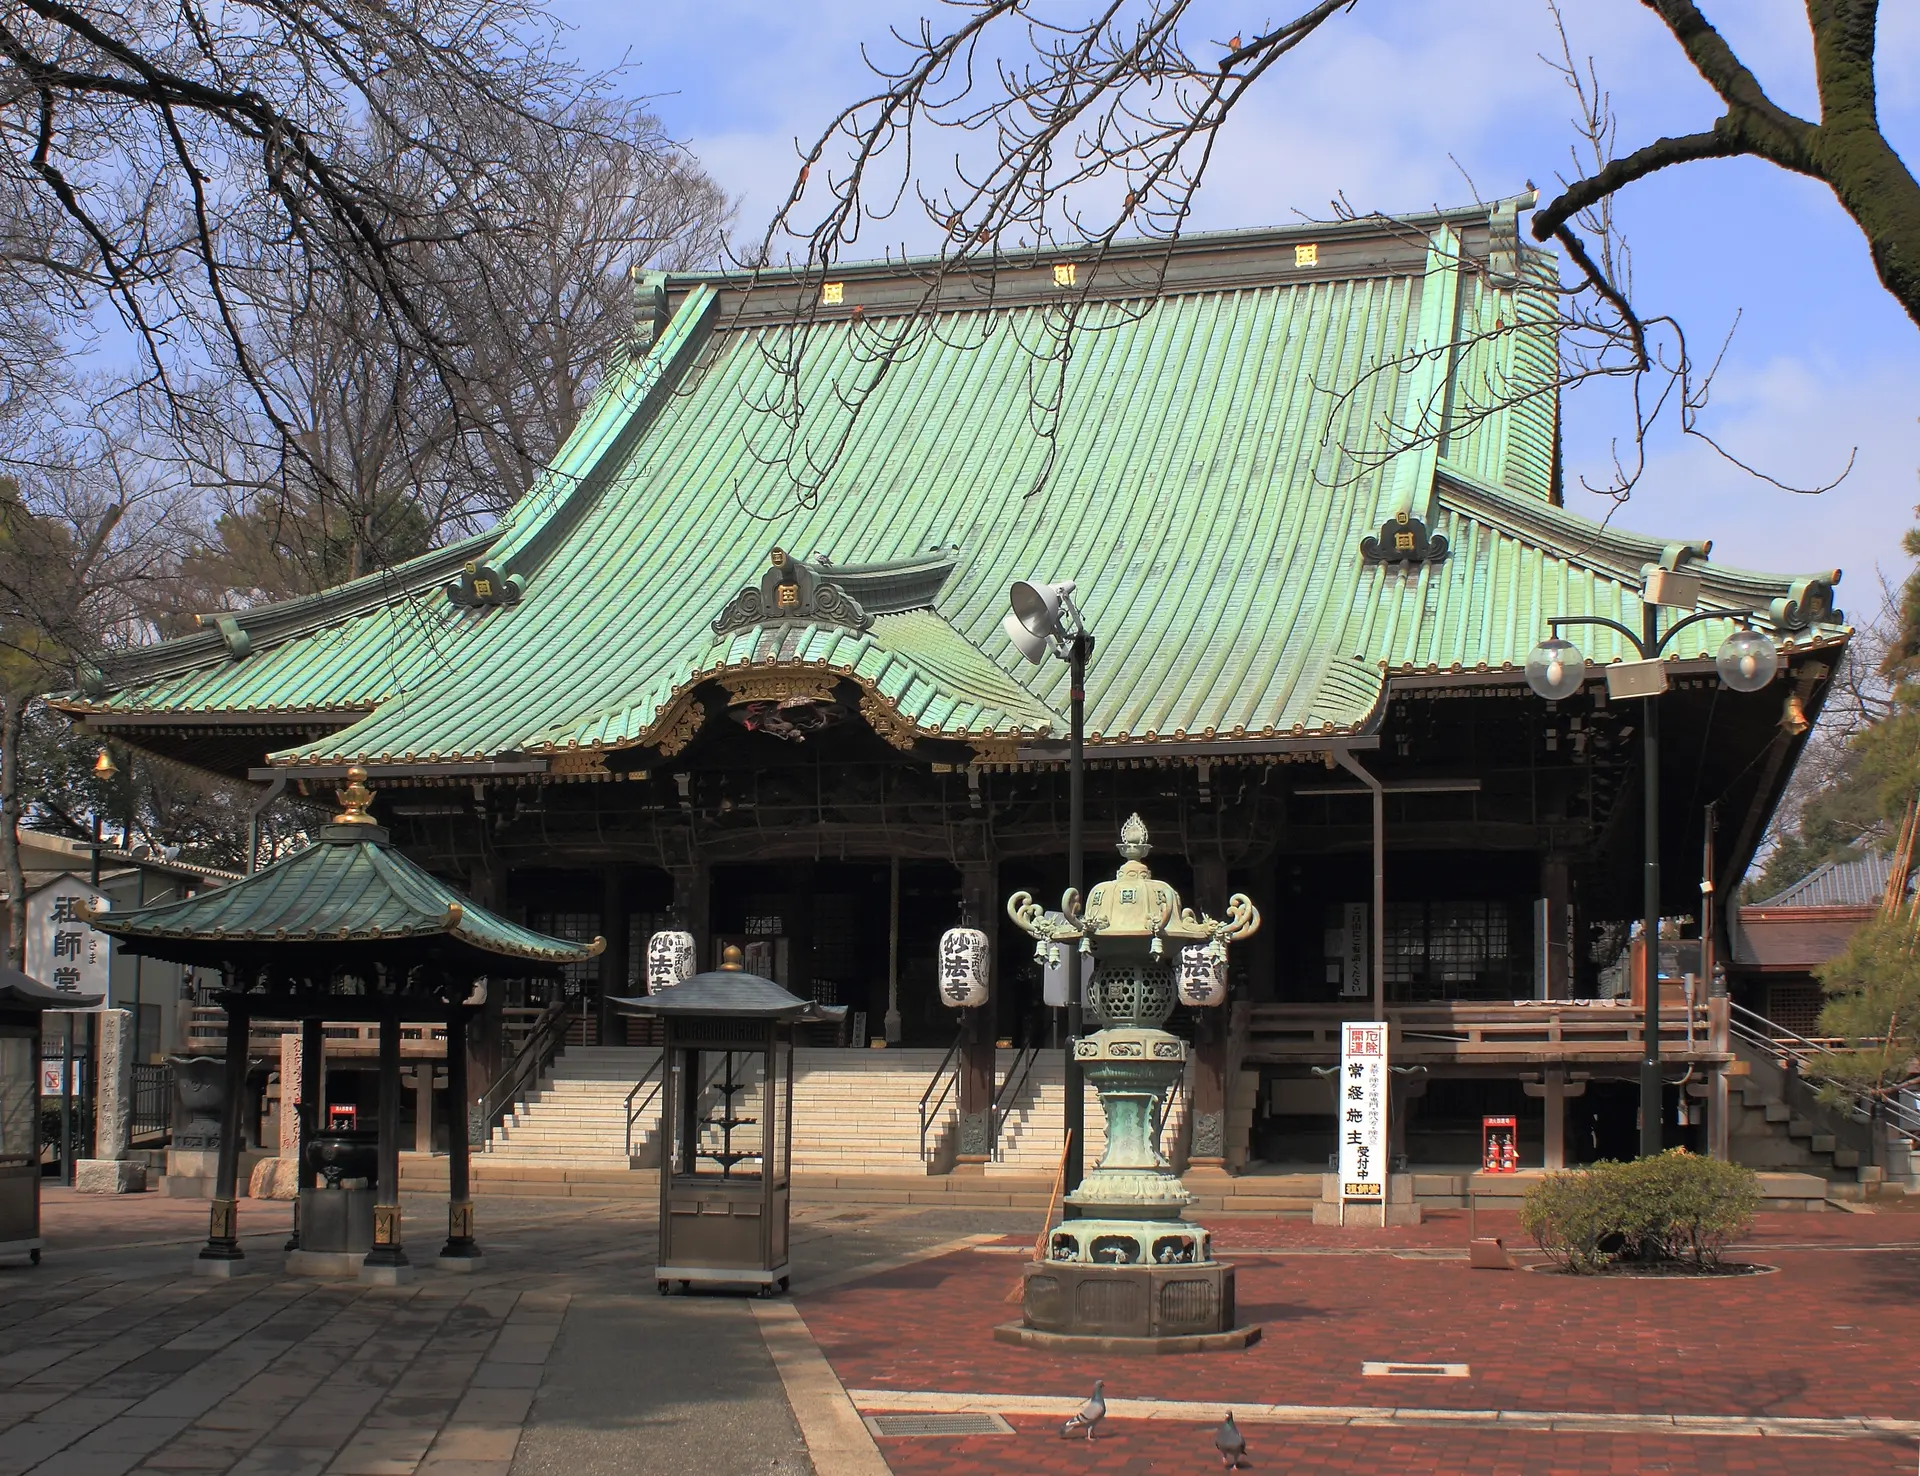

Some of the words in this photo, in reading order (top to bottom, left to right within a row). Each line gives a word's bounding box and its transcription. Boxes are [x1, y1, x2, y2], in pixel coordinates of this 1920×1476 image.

[50, 896, 82, 995] 祖師堂
[944, 932, 970, 1001] 妙法寺
[1183, 945, 1213, 1001] 法寺
[1351, 1030, 1364, 1054] 開運
[1365, 1030, 1379, 1054] 厄除
[1346, 1062, 1365, 1145] 常経施主
[1357, 1146, 1370, 1181] 受付中
[1346, 1184, 1380, 1195] 祖師堂
